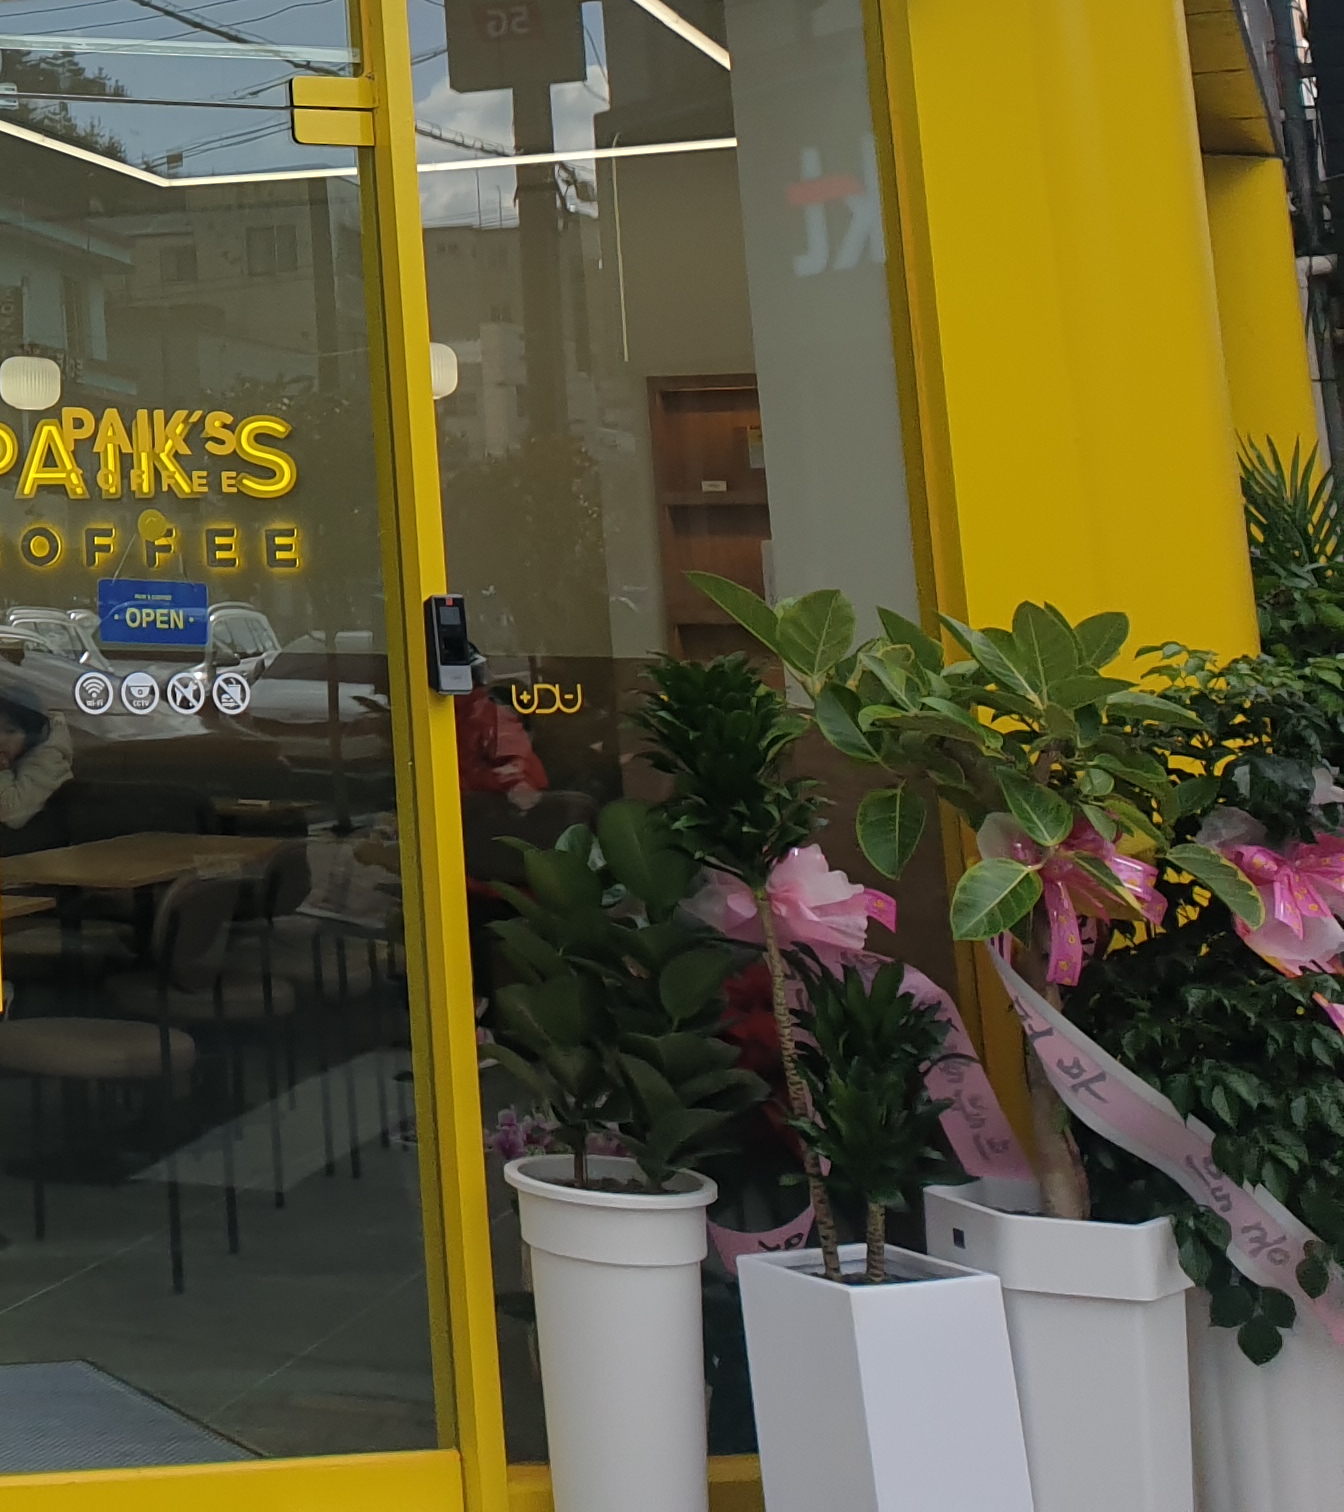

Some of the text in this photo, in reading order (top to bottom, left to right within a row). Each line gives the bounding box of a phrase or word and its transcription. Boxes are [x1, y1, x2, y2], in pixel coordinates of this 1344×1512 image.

[61, 407, 237, 456] PAIK'S
[65, 468, 239, 494] COFFEE
[125, 607, 184, 630] OPEN
